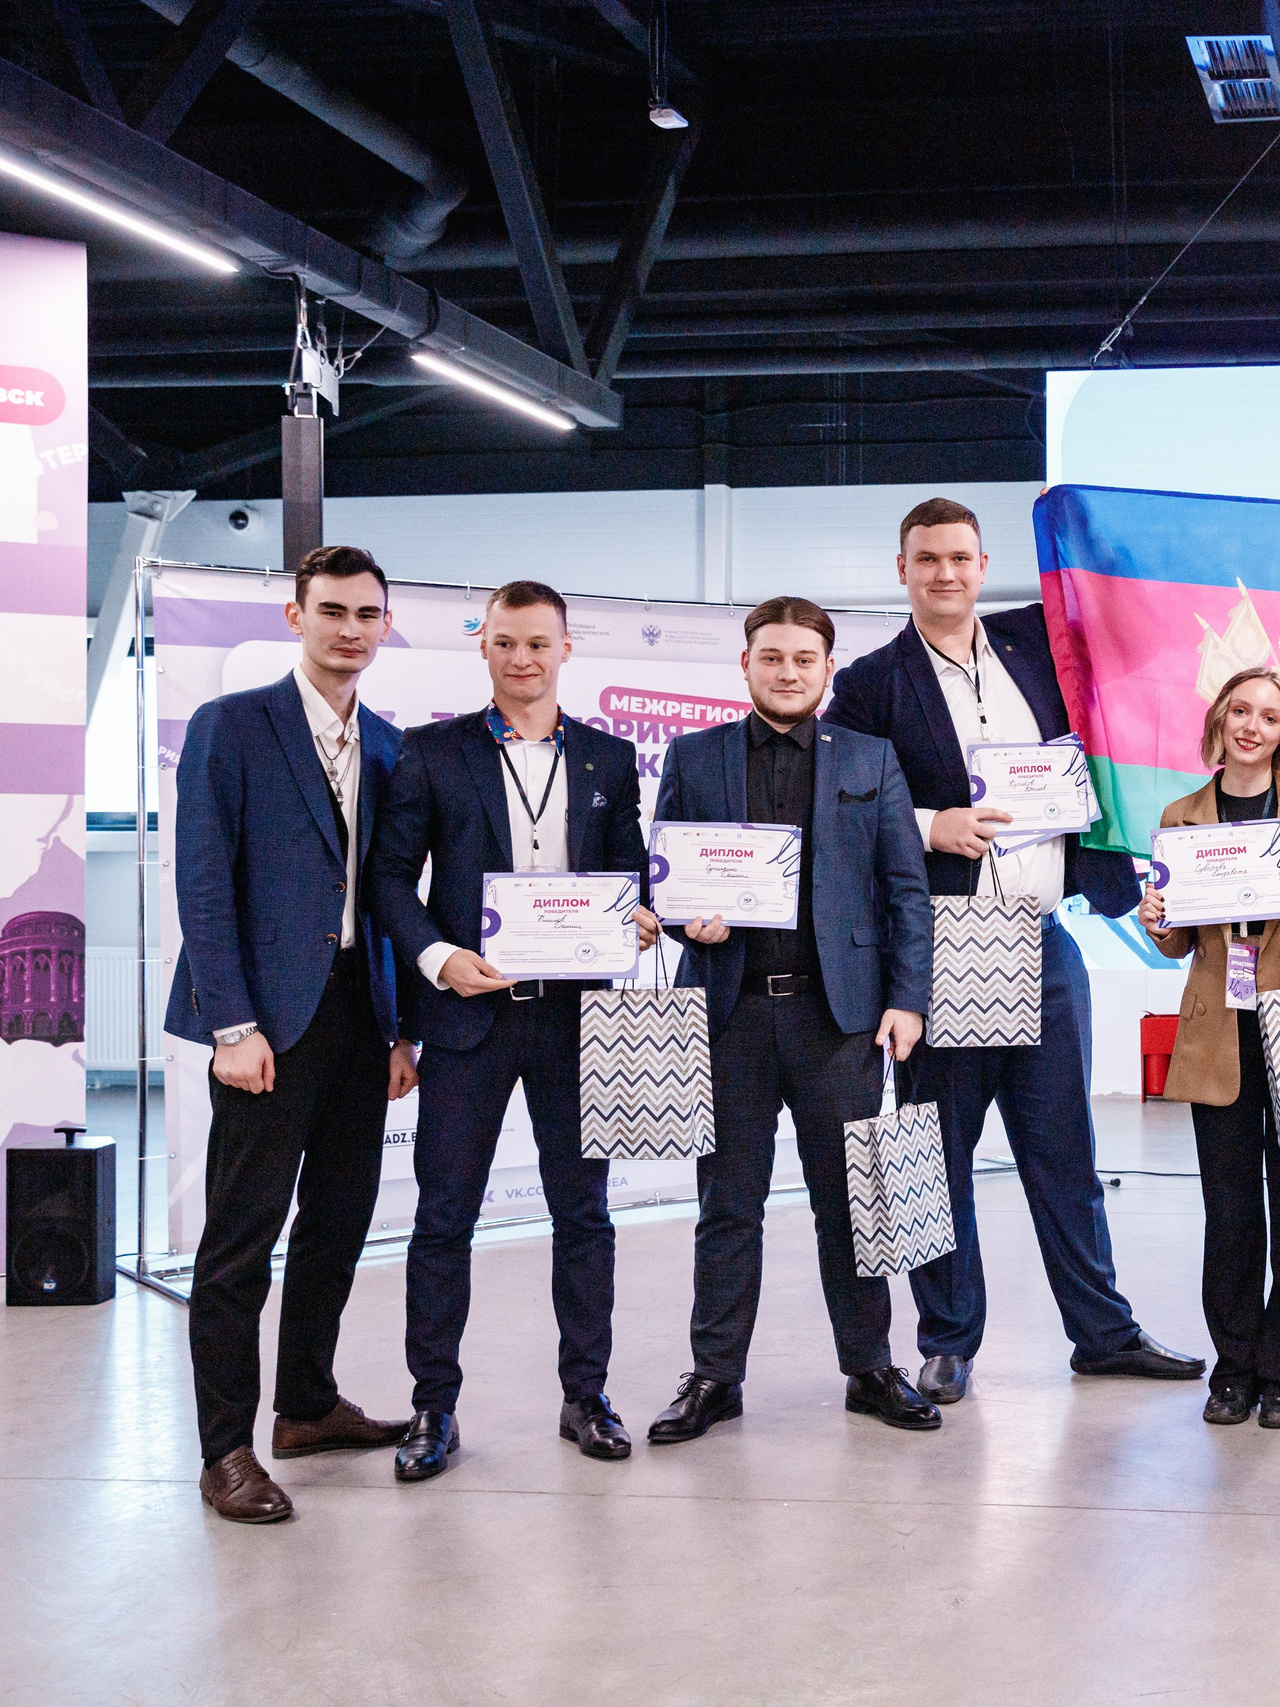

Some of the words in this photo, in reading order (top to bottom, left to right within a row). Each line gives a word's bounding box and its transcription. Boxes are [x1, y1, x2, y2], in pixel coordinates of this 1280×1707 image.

[1009, 765, 1052, 775] ДИПЛОМ
[700, 848, 753, 858] ДИПЛОМ
[1195, 846, 1247, 859] ДИПЛОМ
[533, 899, 590, 909] ДИПЛОМ
